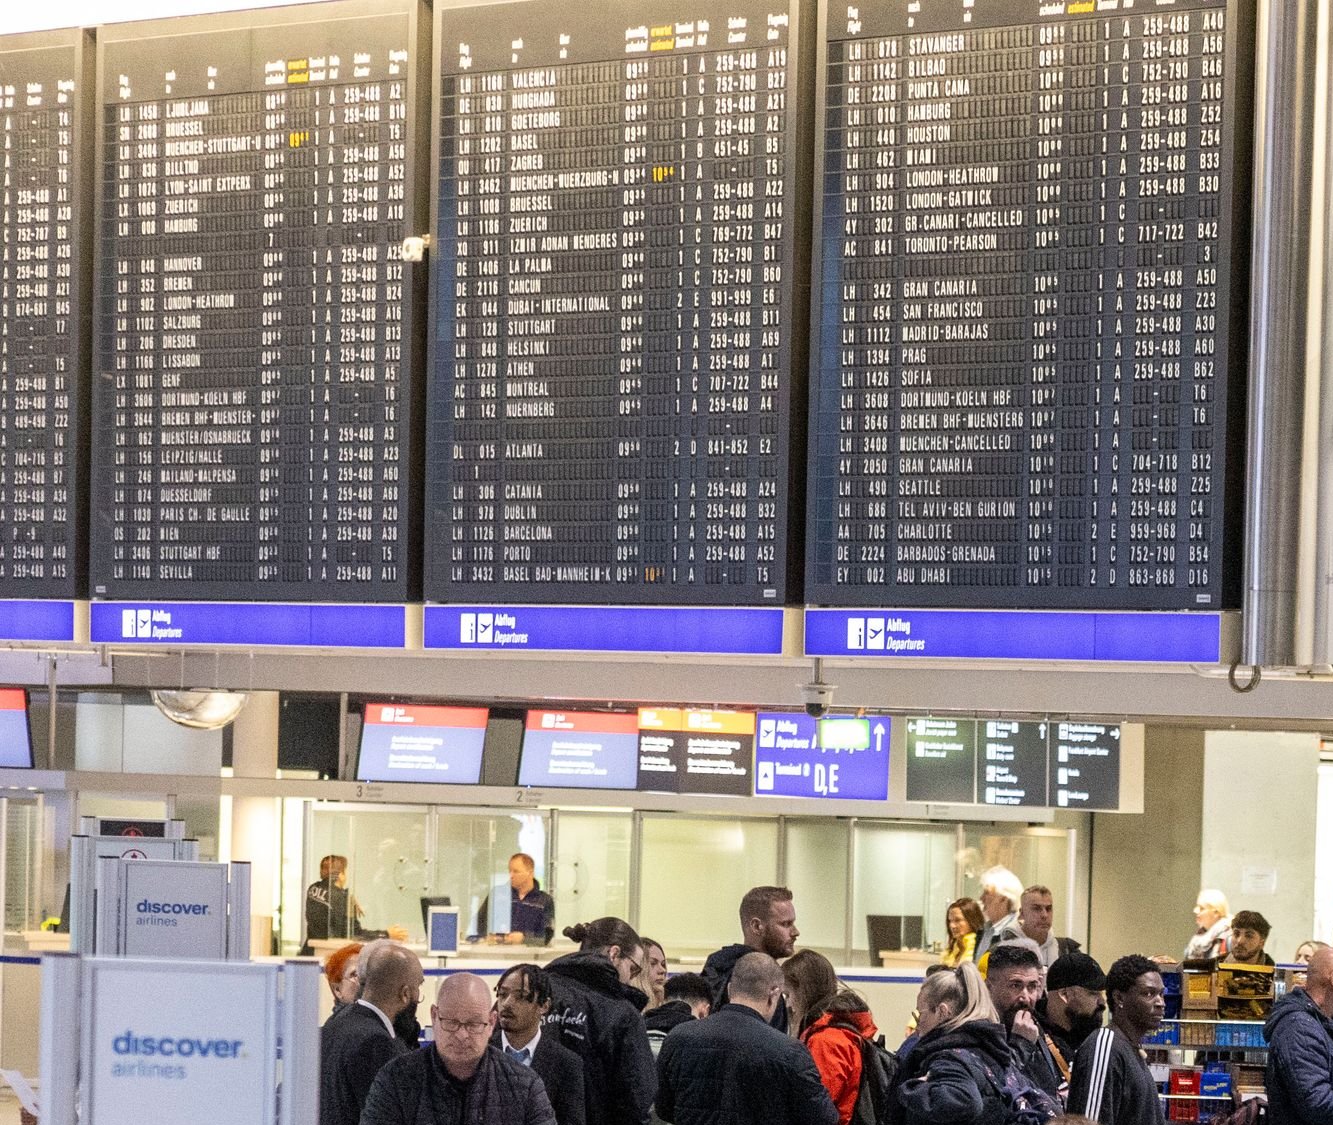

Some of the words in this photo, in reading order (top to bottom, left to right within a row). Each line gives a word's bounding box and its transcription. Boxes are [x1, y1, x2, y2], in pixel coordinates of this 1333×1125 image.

[910, 34, 965, 55] STAVANGER
[909, 58, 946, 77] BILBAO
[908, 102, 951, 121] HAMBURG
[907, 124, 951, 143] HOUSTON
[906, 165, 999, 187] LONDON-HEATHROW
[906, 188, 992, 209] LONDON-GATWICK
[905, 232, 997, 253] TORONTO-PEARSON
[904, 280, 929, 297] GRAN
[934, 278, 978, 295] CANARIA
[903, 302, 922, 319] SAN
[928, 300, 983, 318] FRANCISCO
[902, 322, 989, 341] MADRID-BARAJAS
[902, 346, 927, 363] PRAG
[507, 360, 534, 375] ATHEN
[901, 368, 933, 385] SOFIA
[993, 388, 1012, 404] HBF
[900, 412, 938, 429] BREMEN
[506, 443, 544, 457] ATLANTA
[899, 457, 924, 473] GRAN
[930, 456, 973, 472] CANARIA
[505, 484, 543, 498] CATANIA
[899, 479, 942, 495] SEATTLE
[504, 505, 537, 519] DUBLIN
[898, 501, 917, 517] TEL
[923, 501, 972, 517] AVIV-BEN
[978, 500, 1015, 516] GURION
[504, 525, 553, 540] BARCELONA
[898, 523, 953, 539] CHARLOTTE
[504, 546, 531, 560] PORTO
[897, 545, 996, 561] BARBADOS-GRENADA
[503, 567, 531, 581] BASEL
[896, 568, 915, 583] ABU
[921, 568, 952, 583] DHABI
[886, 618, 910, 634] Abflug
[886, 636, 925, 652] Departures
[136, 916, 178, 928] airlines
[112, 1059, 187, 1080] airlines
